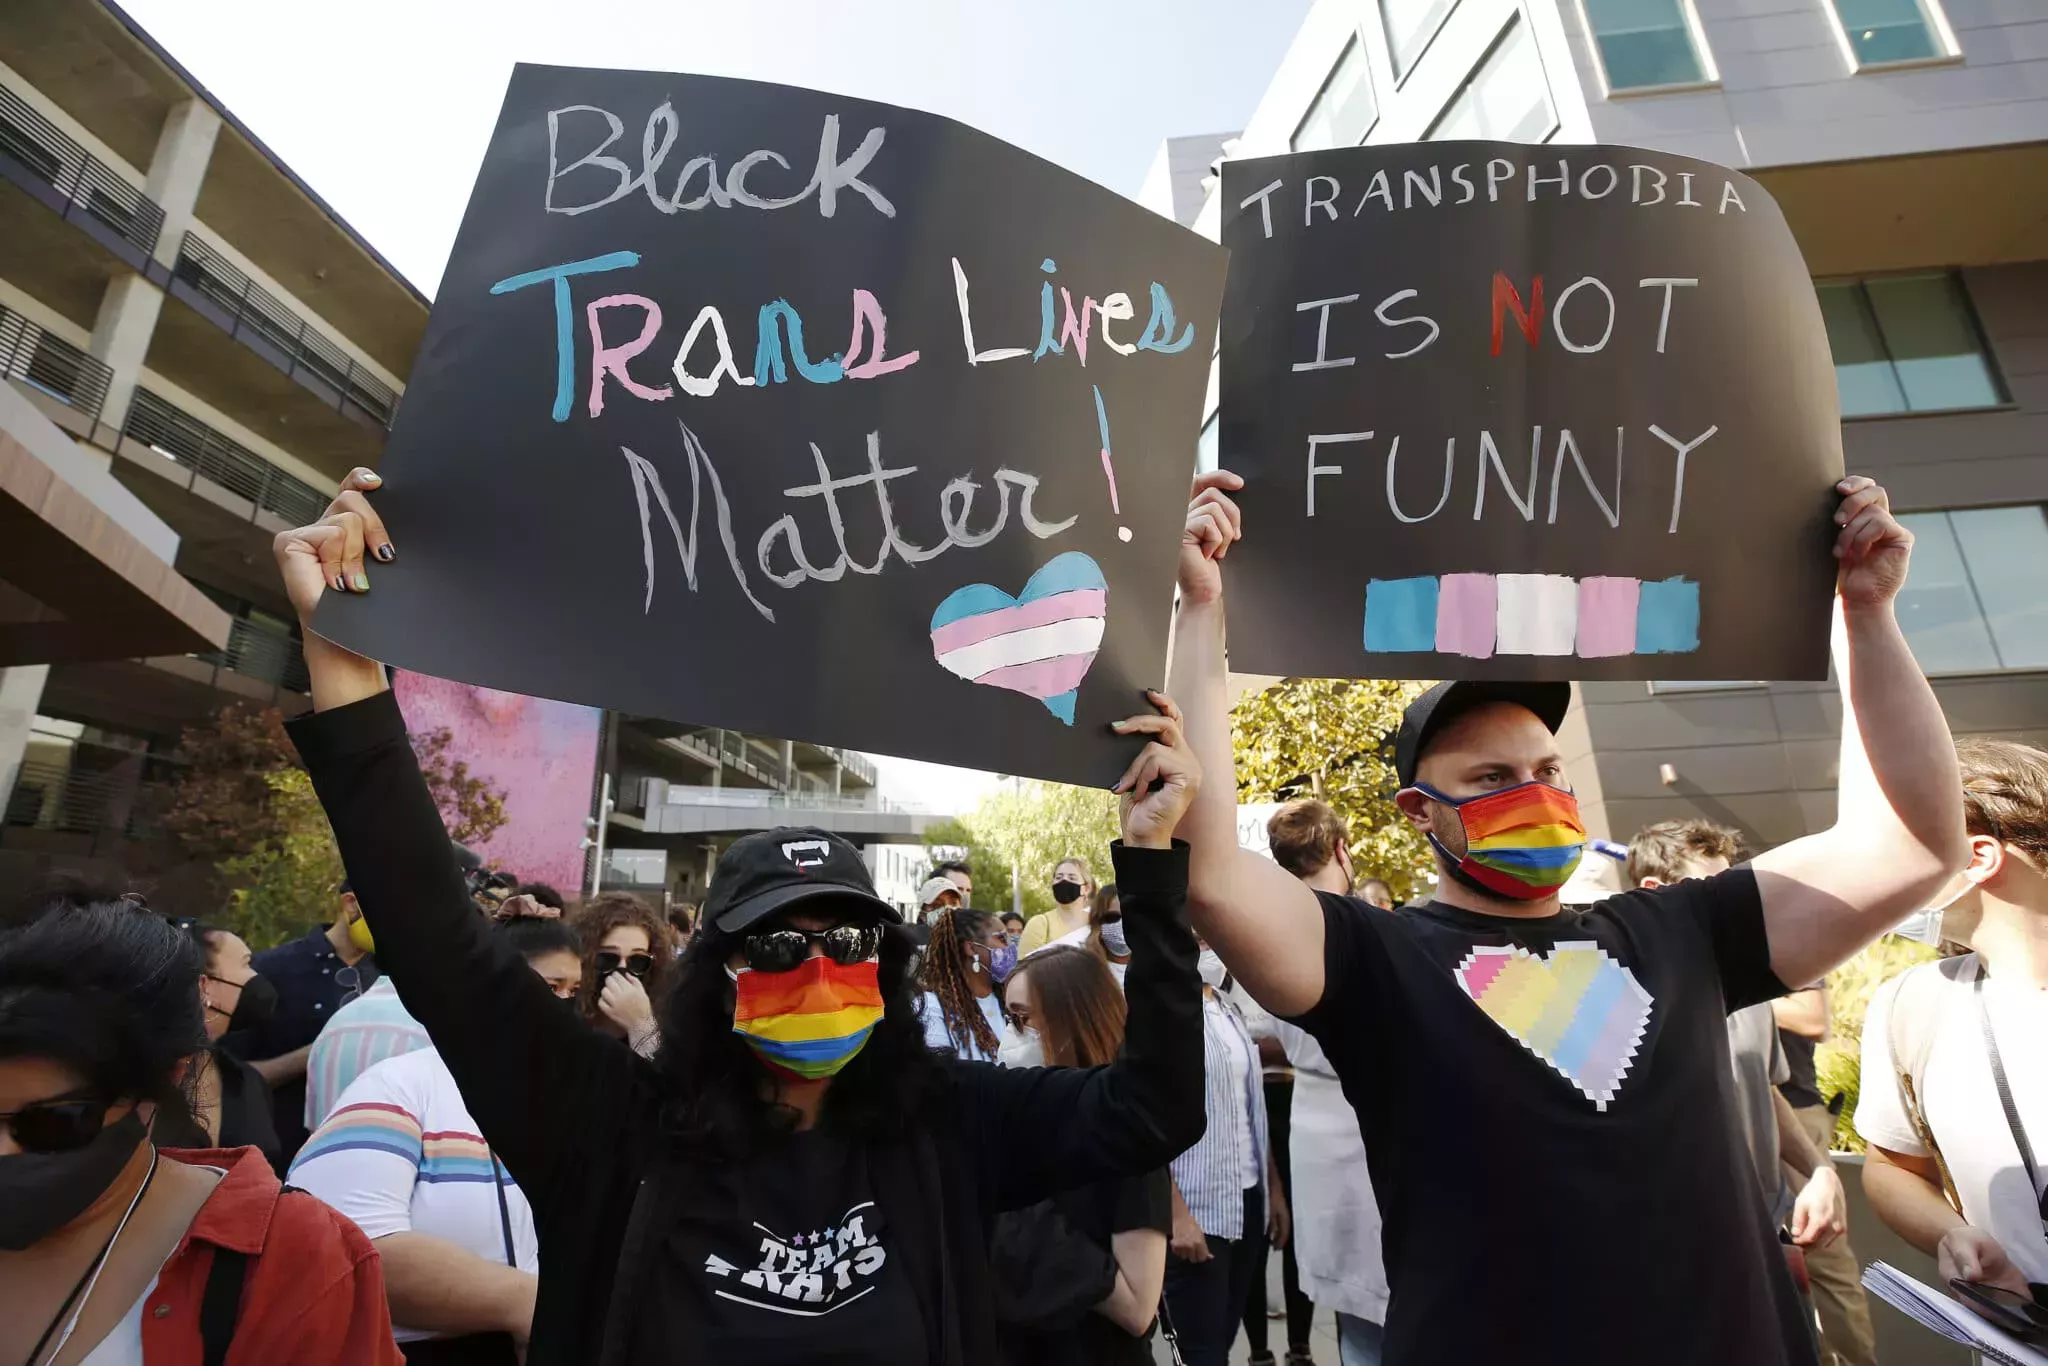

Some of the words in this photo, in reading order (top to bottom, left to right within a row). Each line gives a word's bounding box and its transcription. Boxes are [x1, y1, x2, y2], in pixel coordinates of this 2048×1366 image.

[546, 100, 896, 218] Black
[1240, 158, 1747, 239] TRANSPHOBIA
[951, 257, 1195, 367] Lives
[1291, 288, 1441, 372] IS
[1490, 270, 1699, 357] NOT
[1306, 424, 1719, 534] FUNNY
[757, 1215, 868, 1273] TEAM
